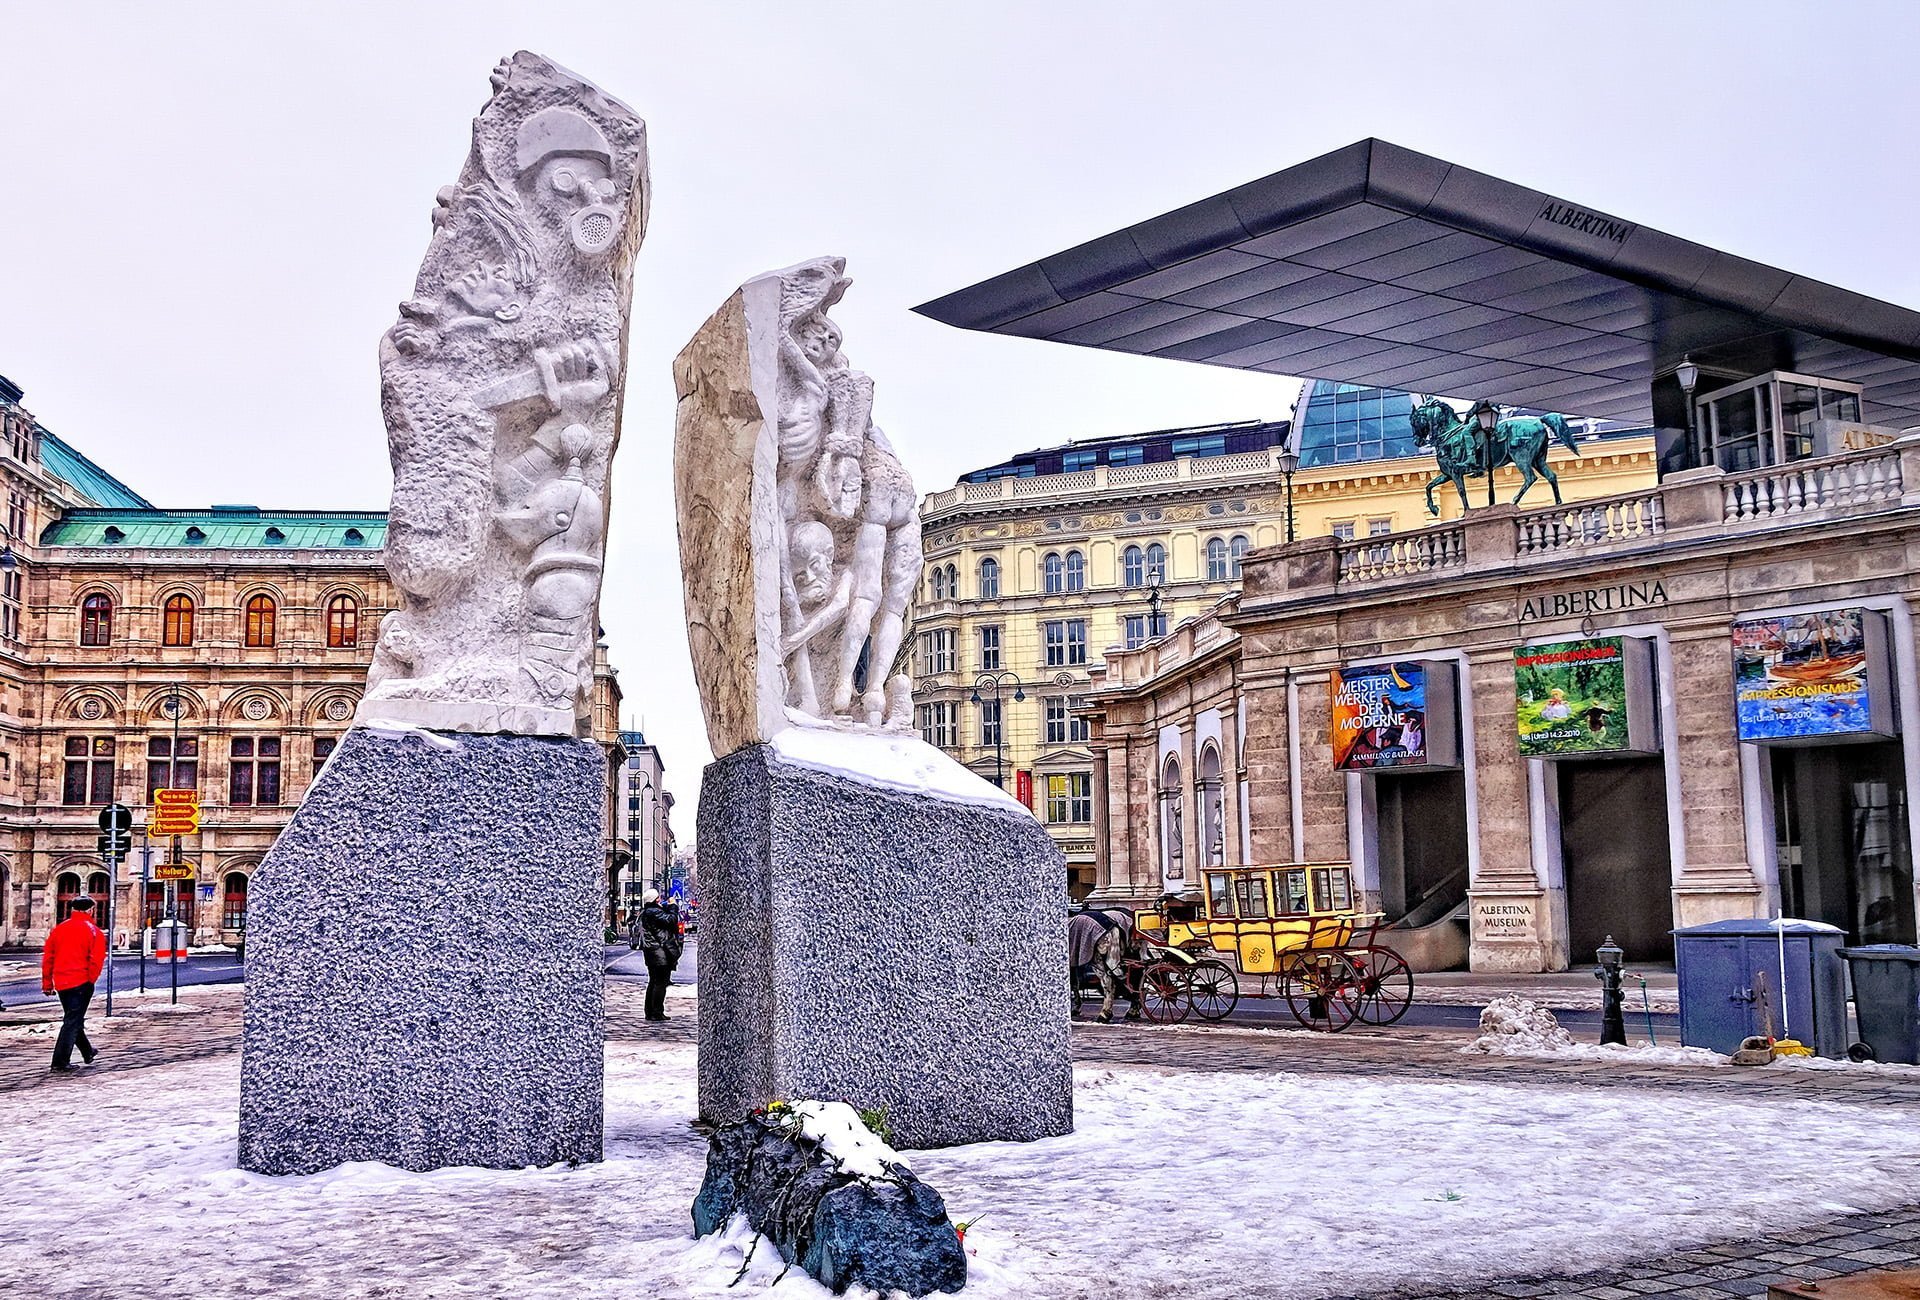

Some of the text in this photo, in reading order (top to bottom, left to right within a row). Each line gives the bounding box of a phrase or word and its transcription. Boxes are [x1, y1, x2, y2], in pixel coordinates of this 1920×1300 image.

[1540, 202, 1629, 243] ALBERTINA
[1520, 580, 1669, 622] ALBERTINA
[1516, 645, 1616, 667] IMPRESSIONISMUS
[1339, 677, 1394, 694] MEISTER-
[1739, 682, 1861, 701] IMPRESSIONISMUS
[1335, 691, 1377, 707] WERKE
[1359, 702, 1385, 716] DER
[1340, 713, 1406, 731] MODERNE
[1352, 752, 1390, 761] SAMMLUNG
[162, 867, 187, 877] Hofburg
[1479, 905, 1531, 915] ALBERTINA
[1484, 918, 1527, 927] MUSEUM
